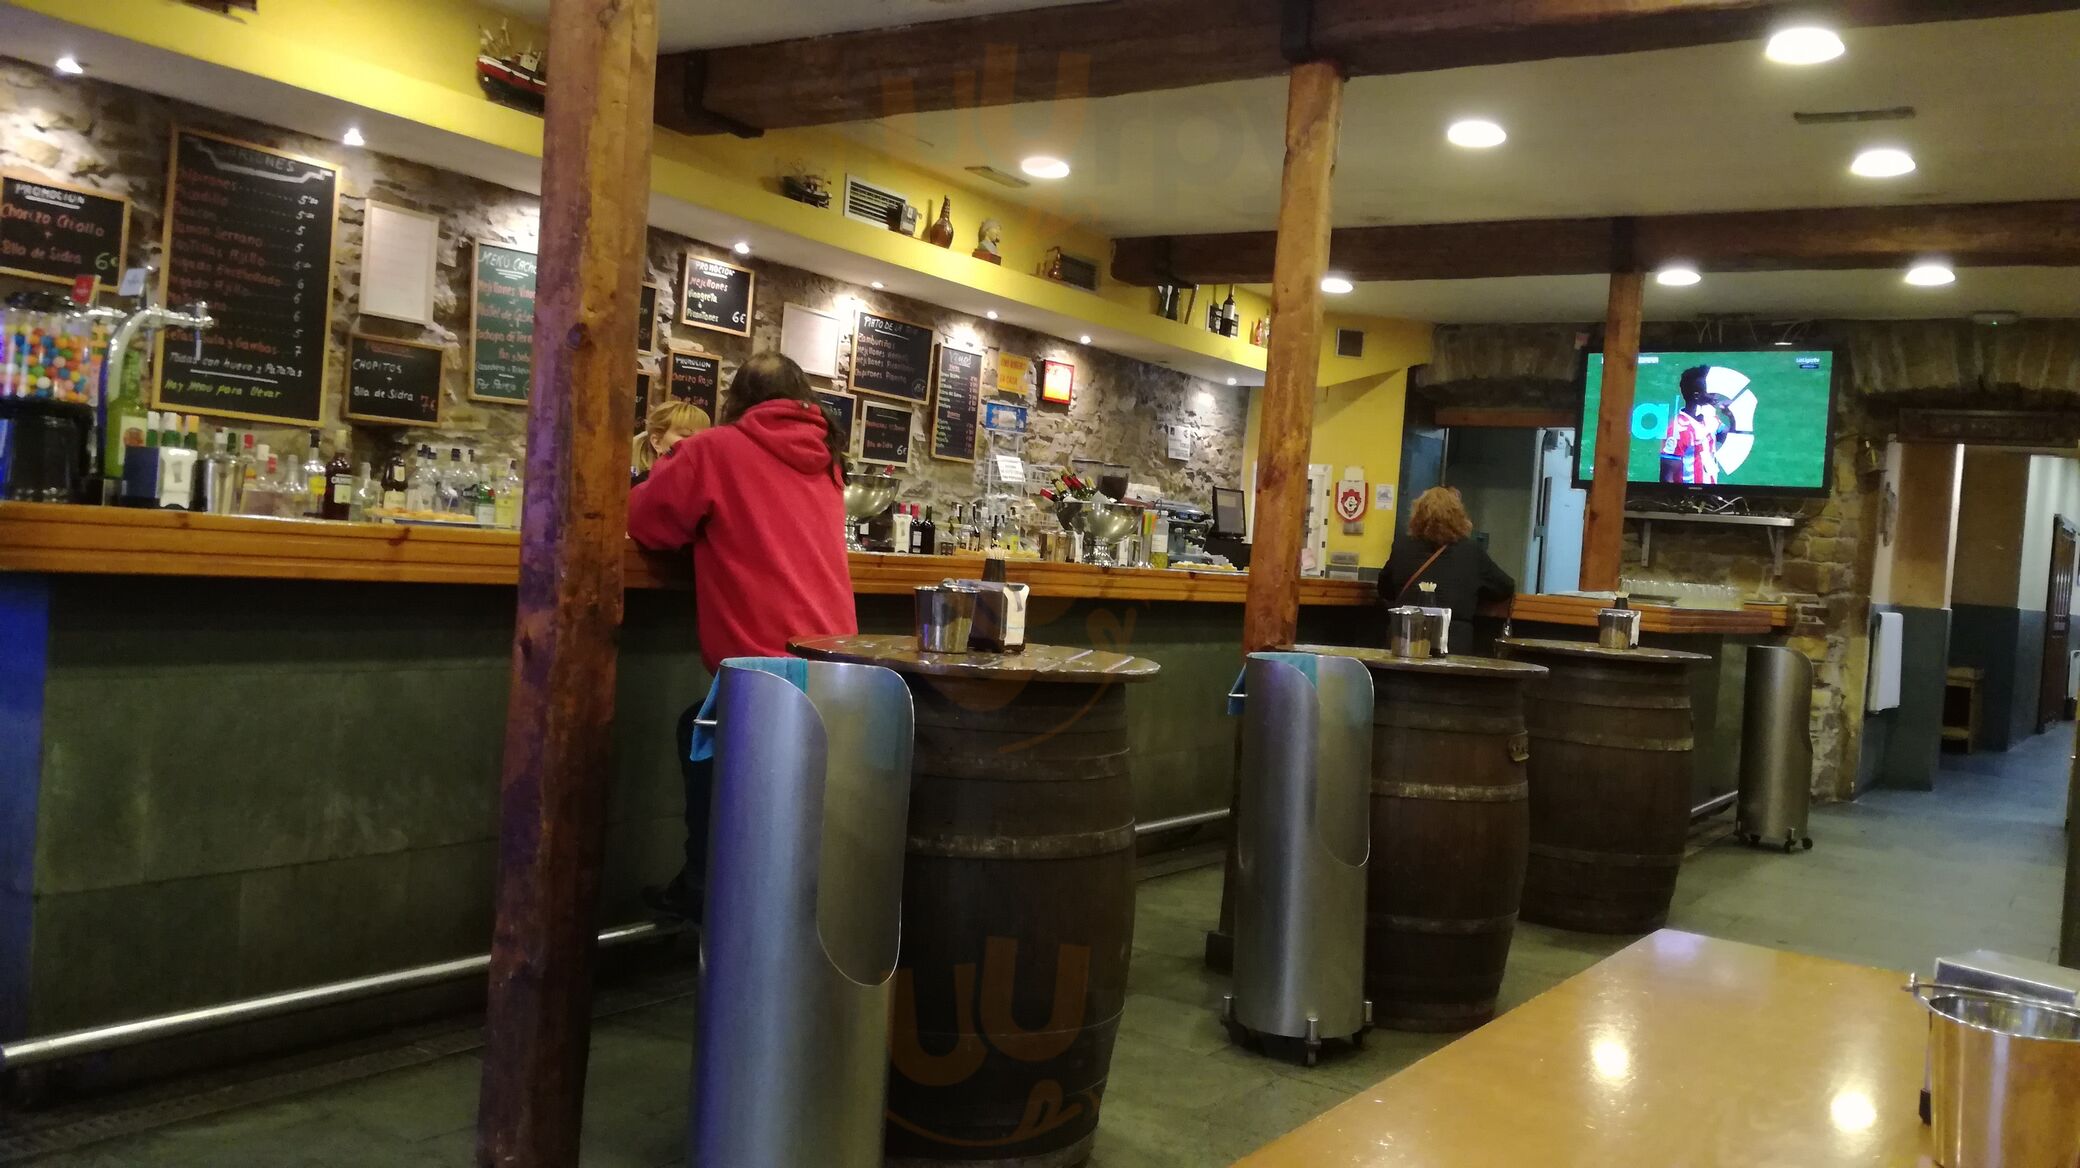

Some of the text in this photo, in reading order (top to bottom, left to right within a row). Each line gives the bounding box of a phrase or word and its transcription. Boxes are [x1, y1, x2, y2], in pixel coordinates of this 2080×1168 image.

[294, 242, 304, 253] 5
[732, 311, 746, 324] 6€
[884, 322, 893, 331] DE
[352, 358, 402, 374] CHOPITOS
[374, 389, 385, 398] de
[387, 389, 414, 402] Sidra
[896, 445, 907, 455] 6€
